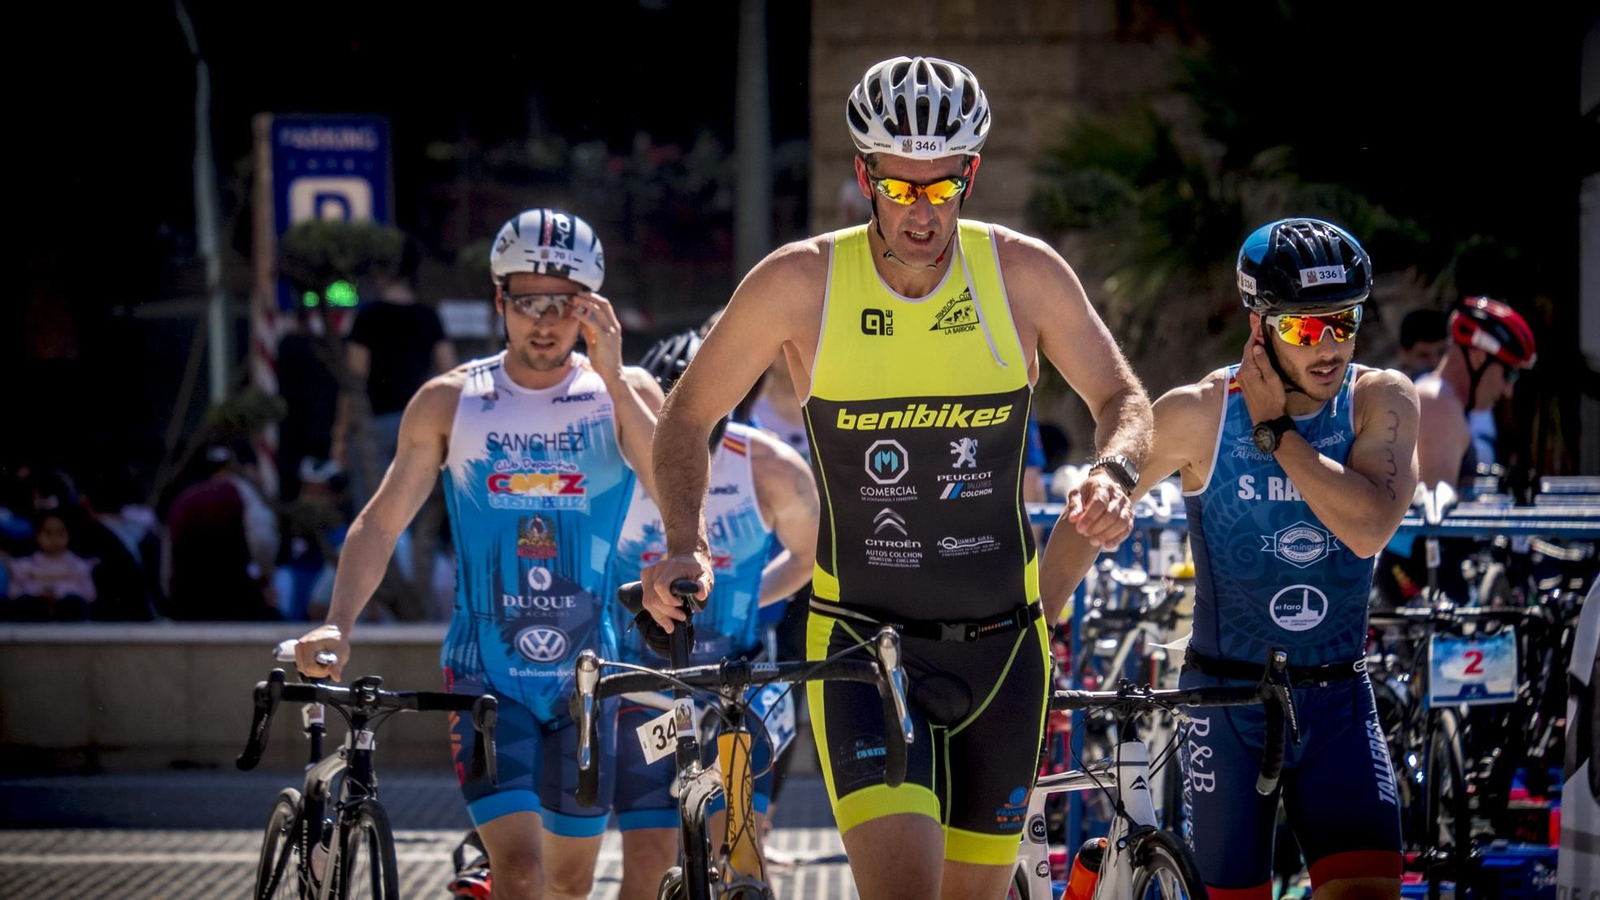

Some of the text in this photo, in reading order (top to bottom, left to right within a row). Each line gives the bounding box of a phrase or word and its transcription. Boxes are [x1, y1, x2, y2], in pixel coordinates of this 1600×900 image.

[915, 140, 937, 151] 346
[554, 251, 565, 260] 70
[1318, 270, 1338, 280] 336
[935, 297, 955, 320] TRIATLON
[953, 325, 977, 334] BARROSA
[836, 403, 1013, 431] benibikes
[486, 431, 583, 452] SANCHEZ
[937, 471, 993, 482] PEUGEOT
[860, 486, 918, 497] COMERCIAL
[961, 488, 993, 498] COLCHON
[1238, 474, 1306, 502] S. RA
[865, 549, 923, 559] AUTOS COLCHON
[502, 594, 577, 611] DUQUE
[1283, 603, 1302, 611] faro
[1463, 650, 1484, 675] 2
[509, 667, 576, 677] Bahiamóvi
[1365, 719, 1396, 805] TALLERES
